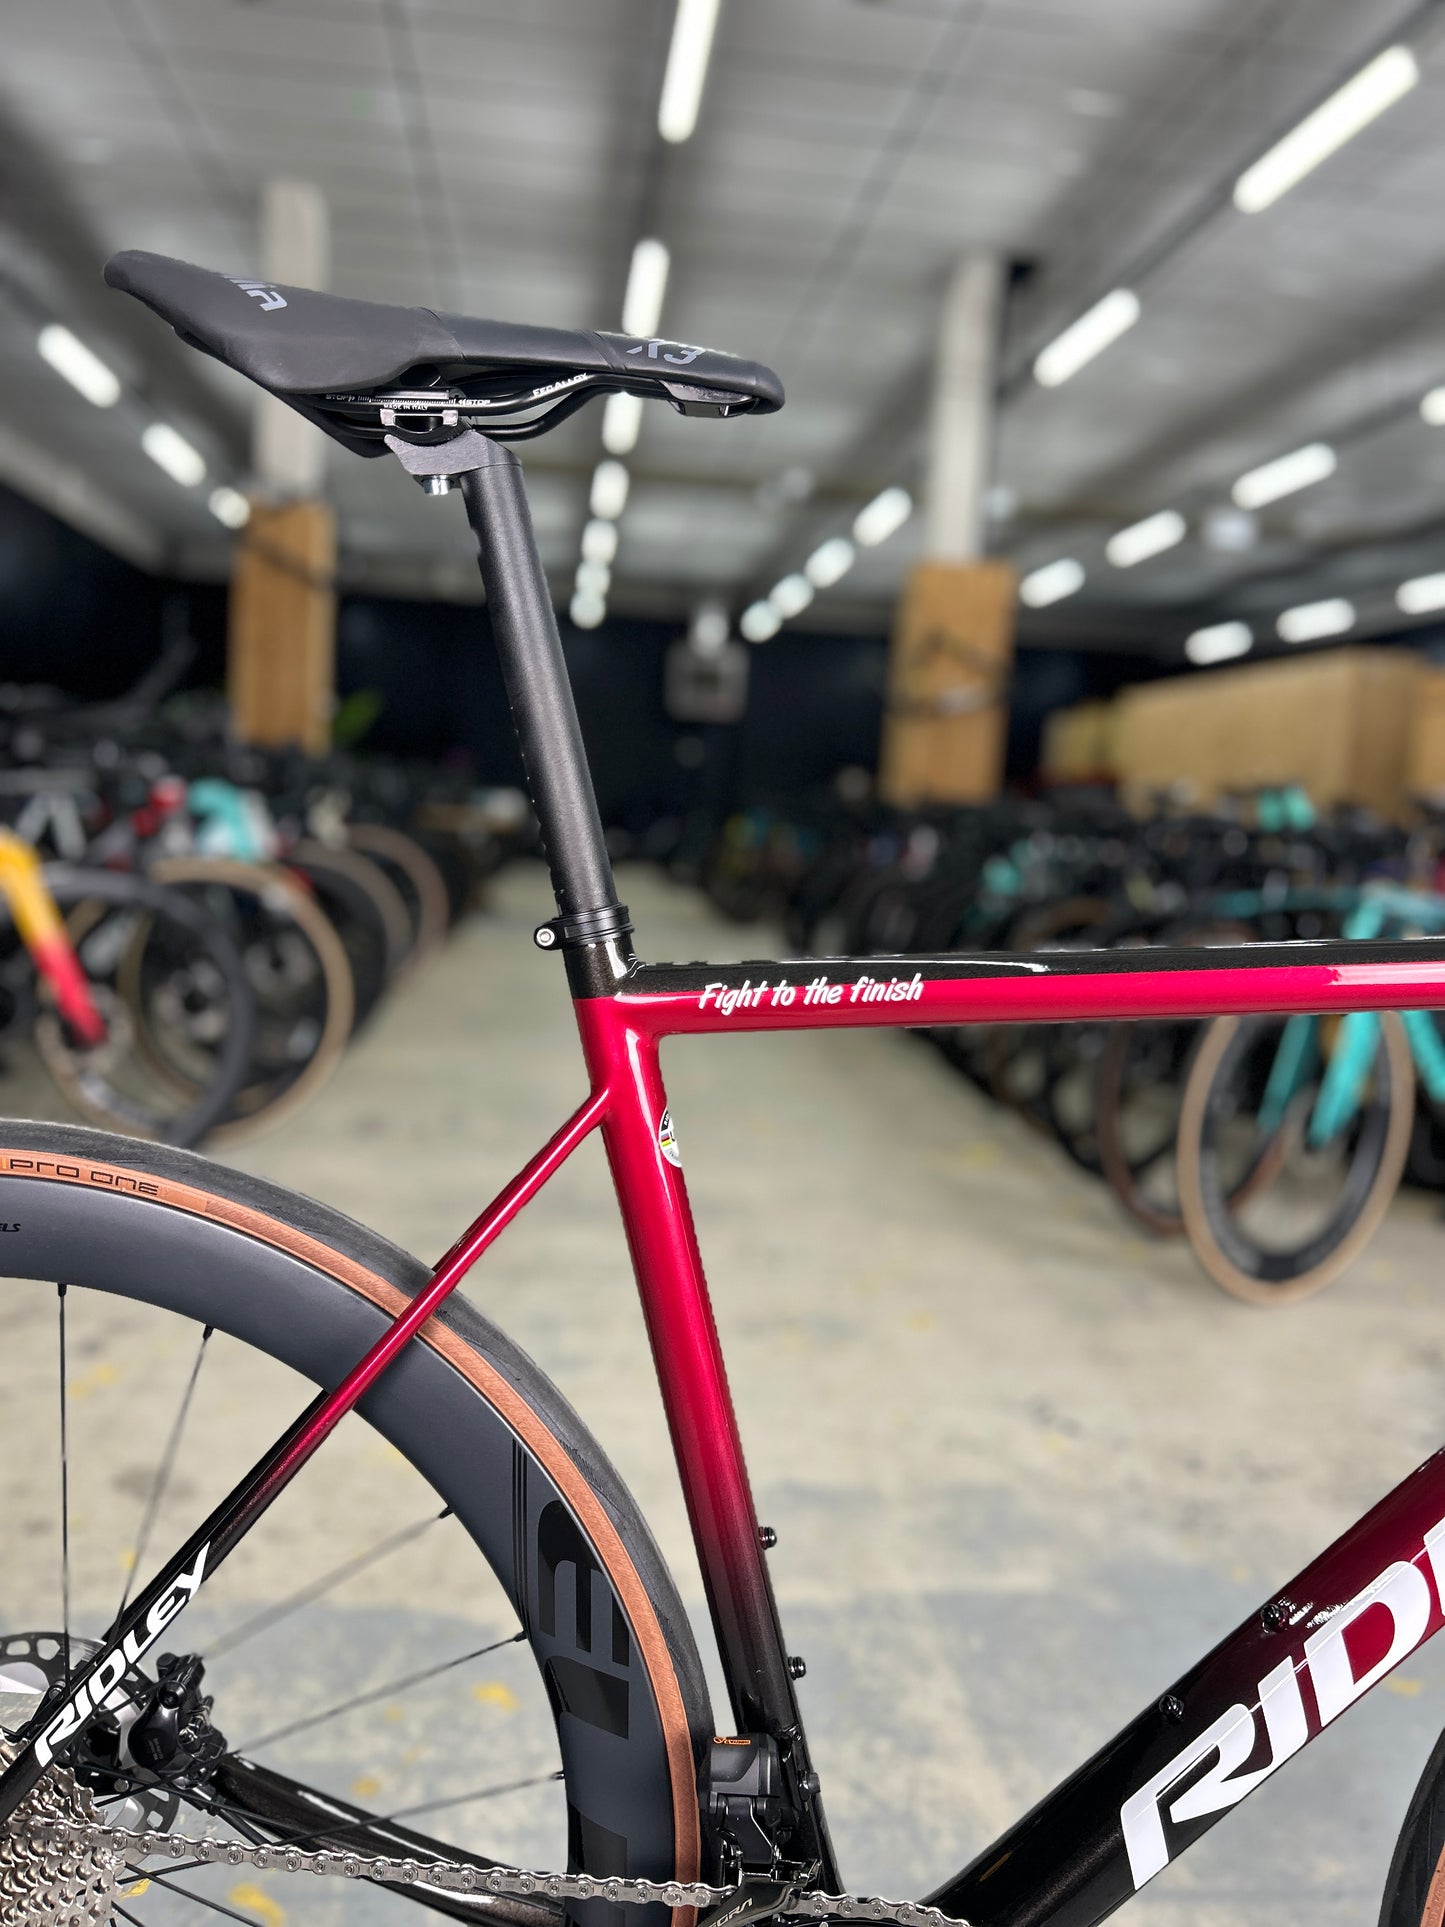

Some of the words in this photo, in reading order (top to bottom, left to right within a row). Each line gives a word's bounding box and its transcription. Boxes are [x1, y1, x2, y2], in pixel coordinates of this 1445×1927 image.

[698, 979, 769, 1016] Fight
[770, 980, 798, 1007] to
[803, 976, 842, 1006] the
[849, 972, 924, 1003] finish
[34, 1541, 211, 1767] RIDLEY
